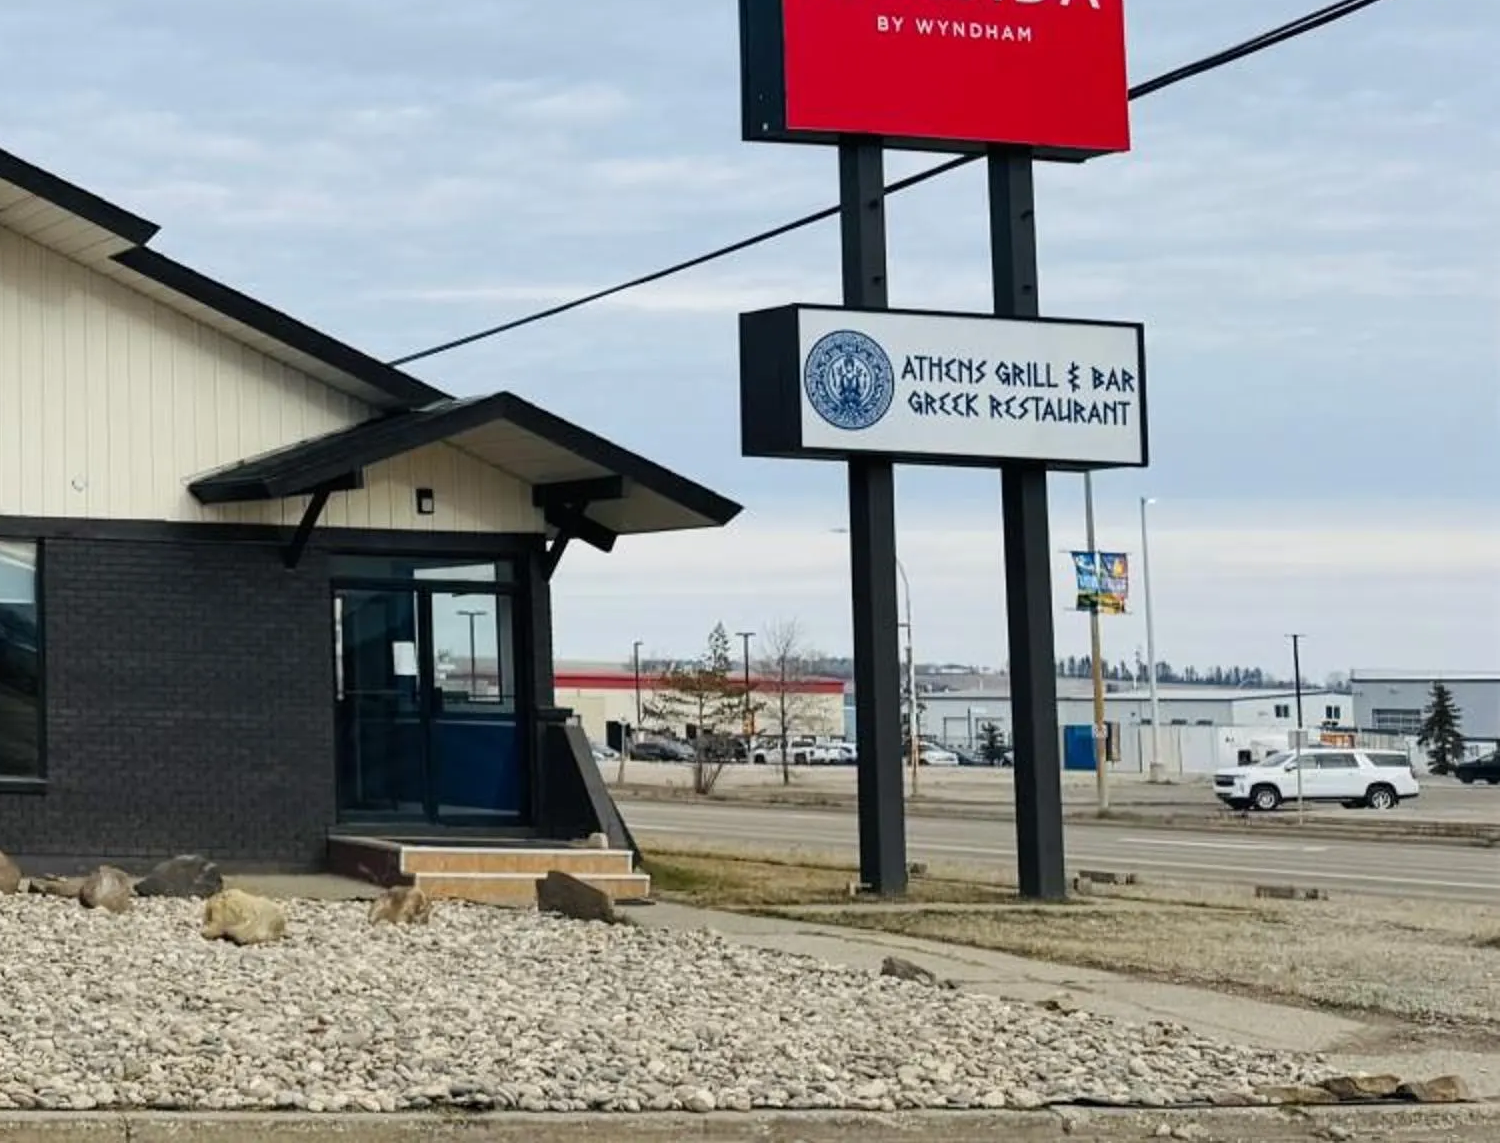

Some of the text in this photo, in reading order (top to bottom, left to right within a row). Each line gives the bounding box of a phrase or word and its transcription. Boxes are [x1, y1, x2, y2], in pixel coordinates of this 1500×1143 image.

[877, 15, 1032, 42] BY WYNDHAM
[901, 355, 987, 384] ATHENS
[995, 361, 1058, 388] GRILL
[1091, 366, 1135, 392] BAR
[908, 390, 1131, 426] GREEK RESTAURANT
